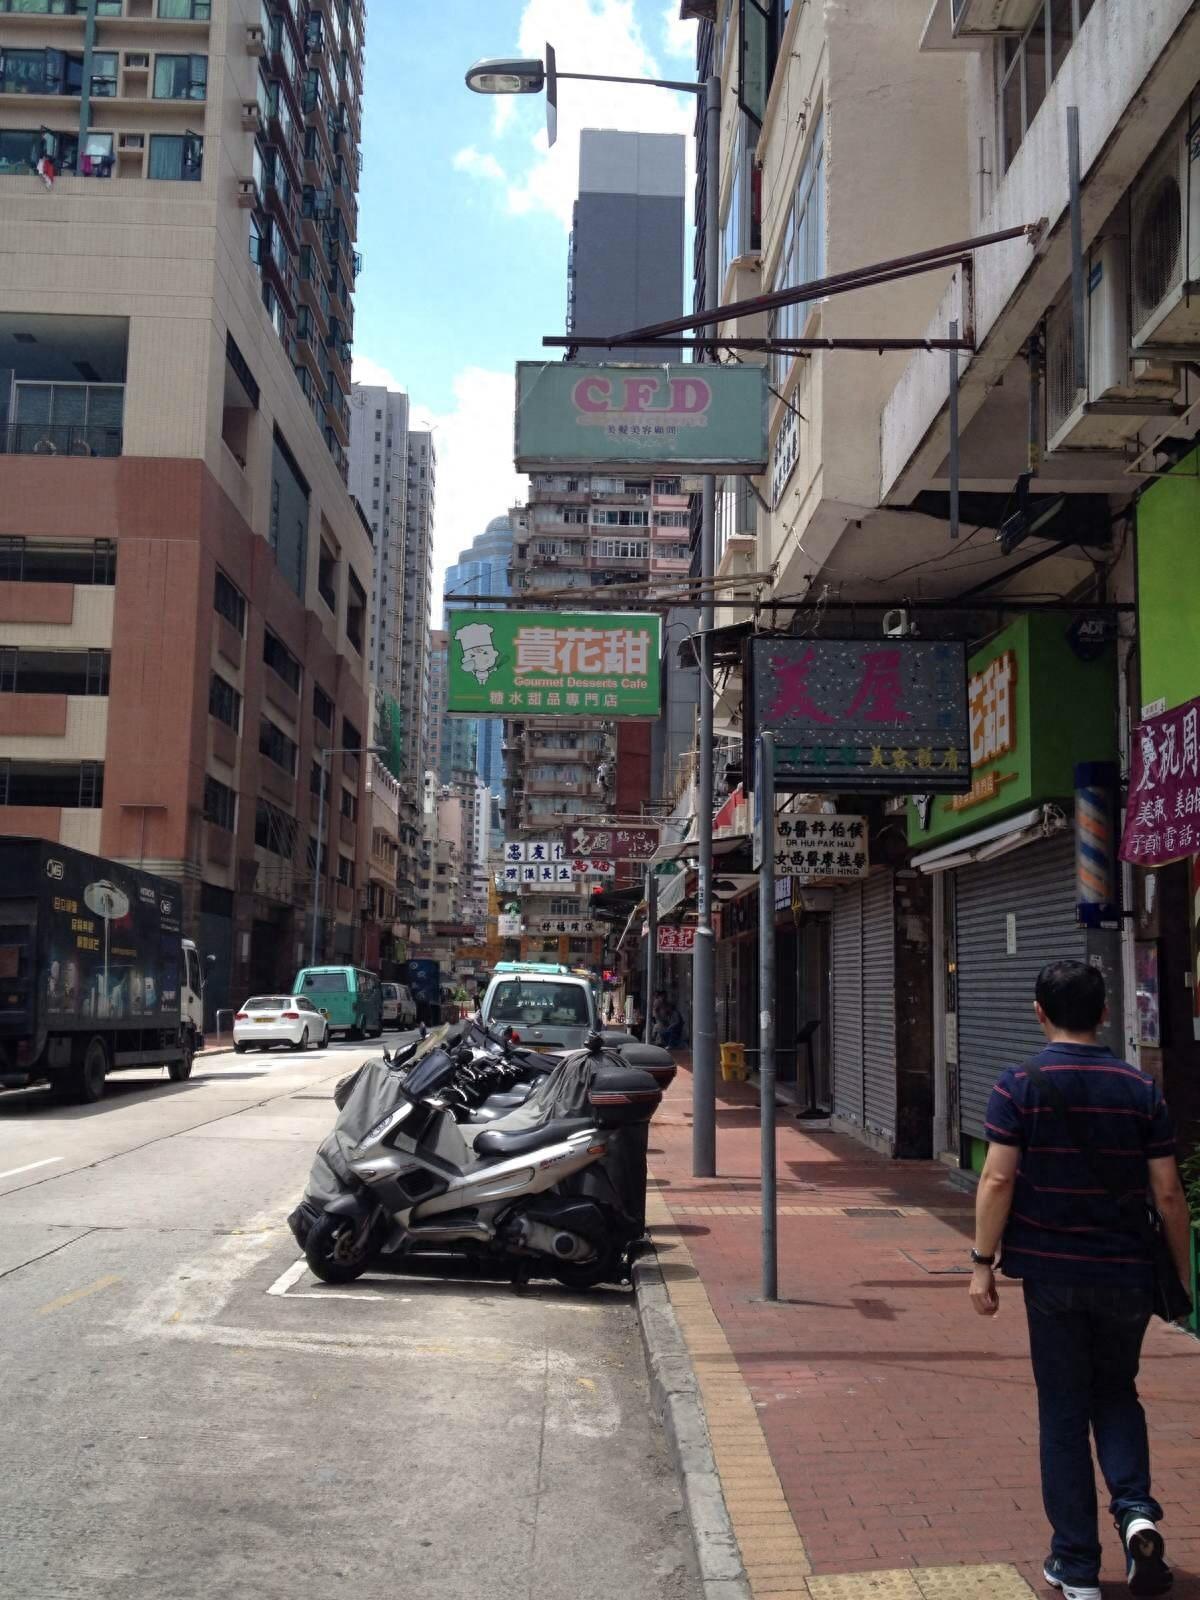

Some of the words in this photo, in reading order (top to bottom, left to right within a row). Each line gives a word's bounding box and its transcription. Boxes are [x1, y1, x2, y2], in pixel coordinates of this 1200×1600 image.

[1077, 621, 1105, 635] ADT
[513, 627, 649, 675] 貴花甜
[513, 676, 564, 688] Gourmet
[567, 677, 618, 688] Desserts
[489, 691, 618, 708] 糖水甜品專門店
